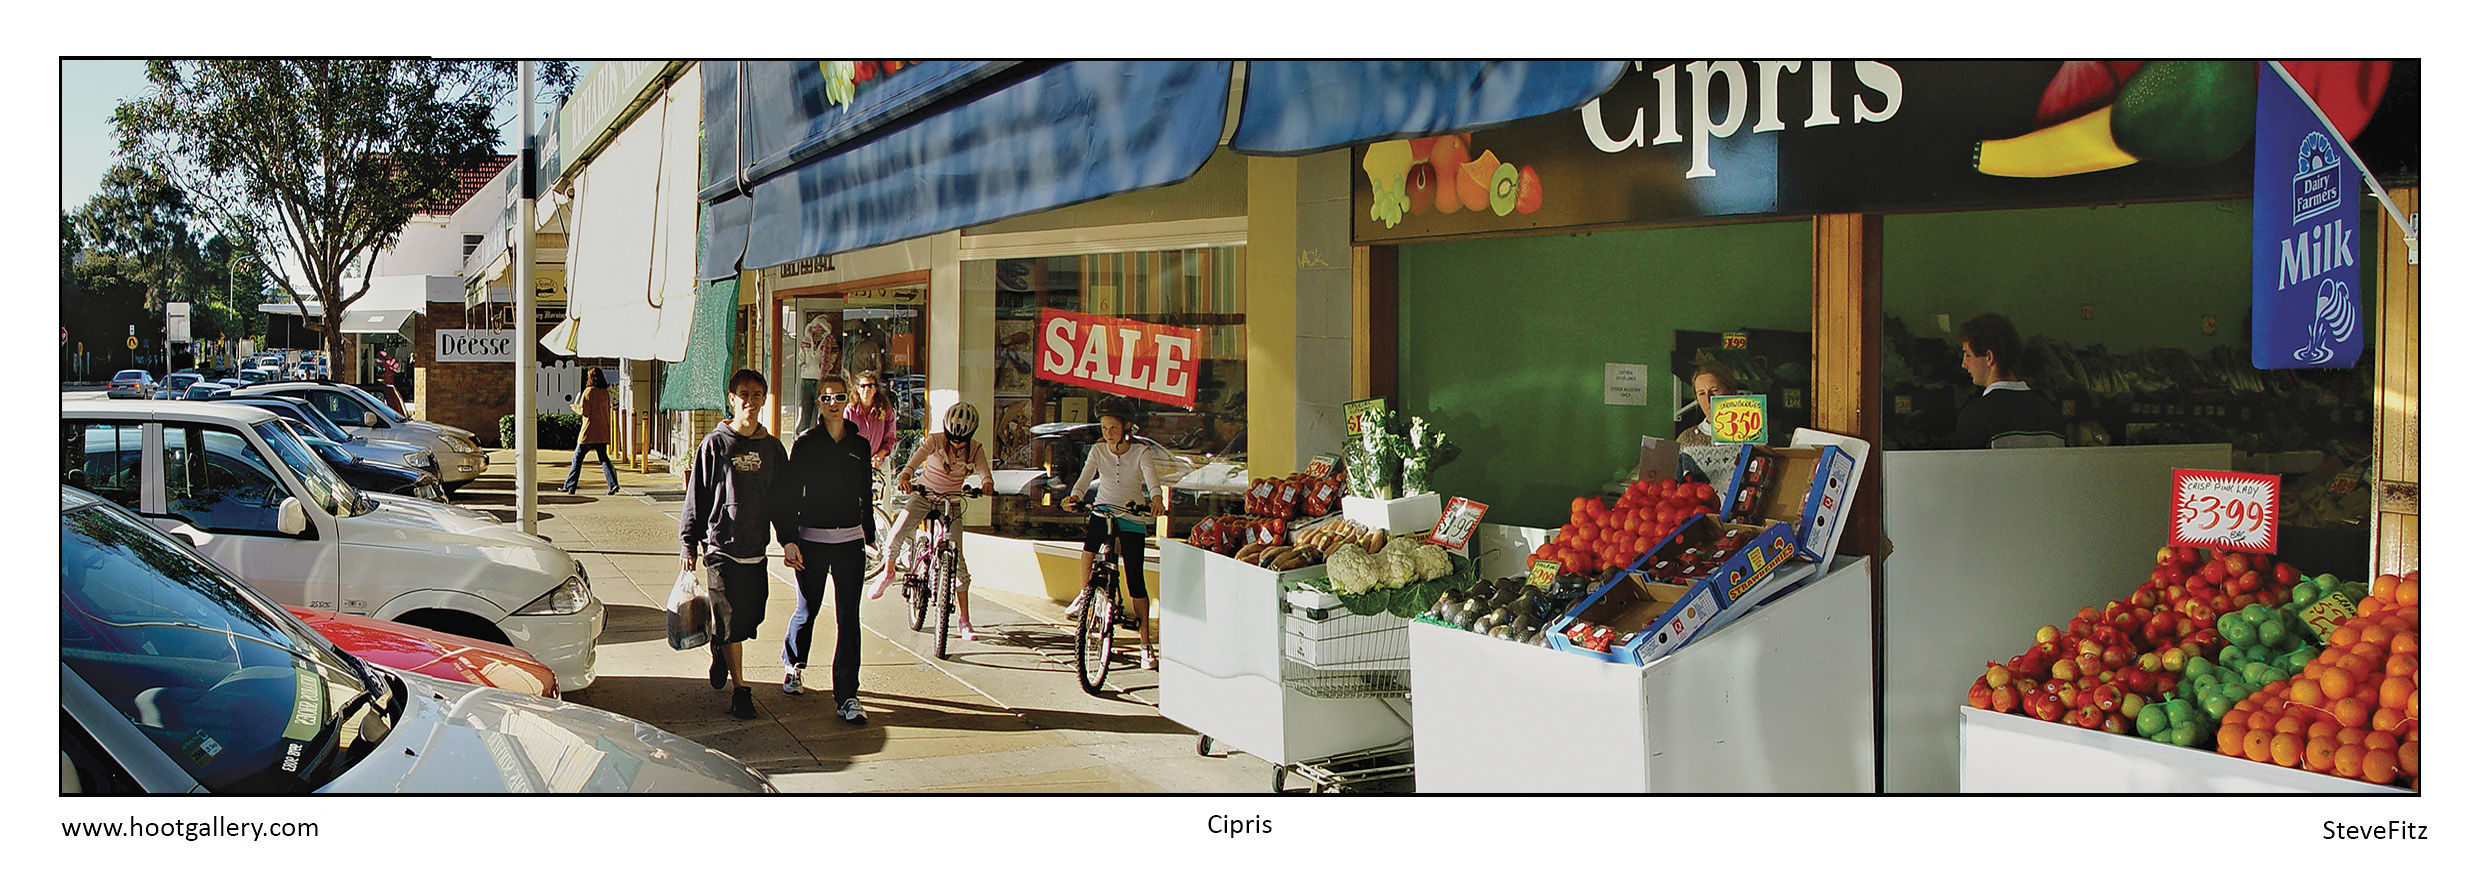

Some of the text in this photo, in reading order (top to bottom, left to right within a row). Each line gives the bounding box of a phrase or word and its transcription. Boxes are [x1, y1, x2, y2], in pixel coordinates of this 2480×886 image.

[1581, 61, 1904, 179] Cipris
[2297, 187, 2337, 212] Farmers
[2304, 174, 2330, 195] Dairy
[2278, 219, 2353, 291] Milk
[1043, 317, 1191, 397] SALE
[1714, 410, 1761, 439] $3.50
[2187, 482, 2260, 499] CRISP PINK LADY
[1728, 543, 1794, 600] STRAWBERRIES
